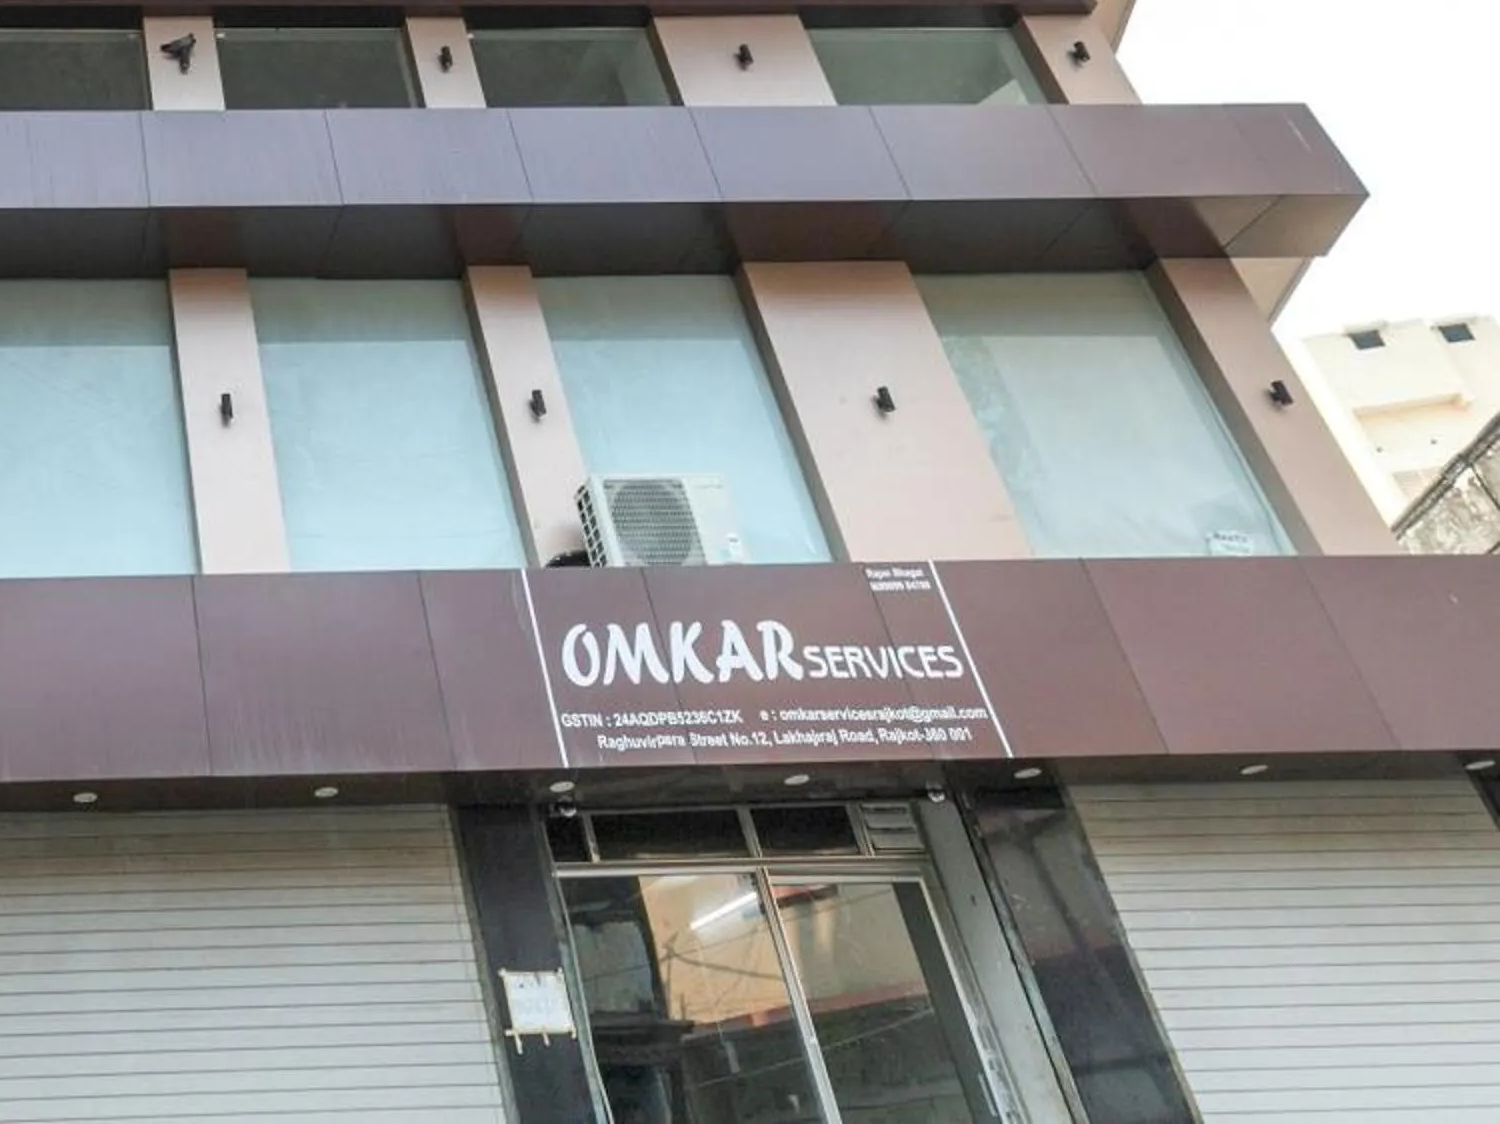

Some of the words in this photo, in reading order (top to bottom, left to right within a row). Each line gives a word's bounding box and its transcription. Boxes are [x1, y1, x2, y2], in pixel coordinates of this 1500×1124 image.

[561, 620, 804, 687] OMKAR
[802, 645, 964, 679] SERVICES
[561, 713, 603, 727] GSTIN
[689, 732, 729, 747] Street
[839, 728, 880, 745] Road,
